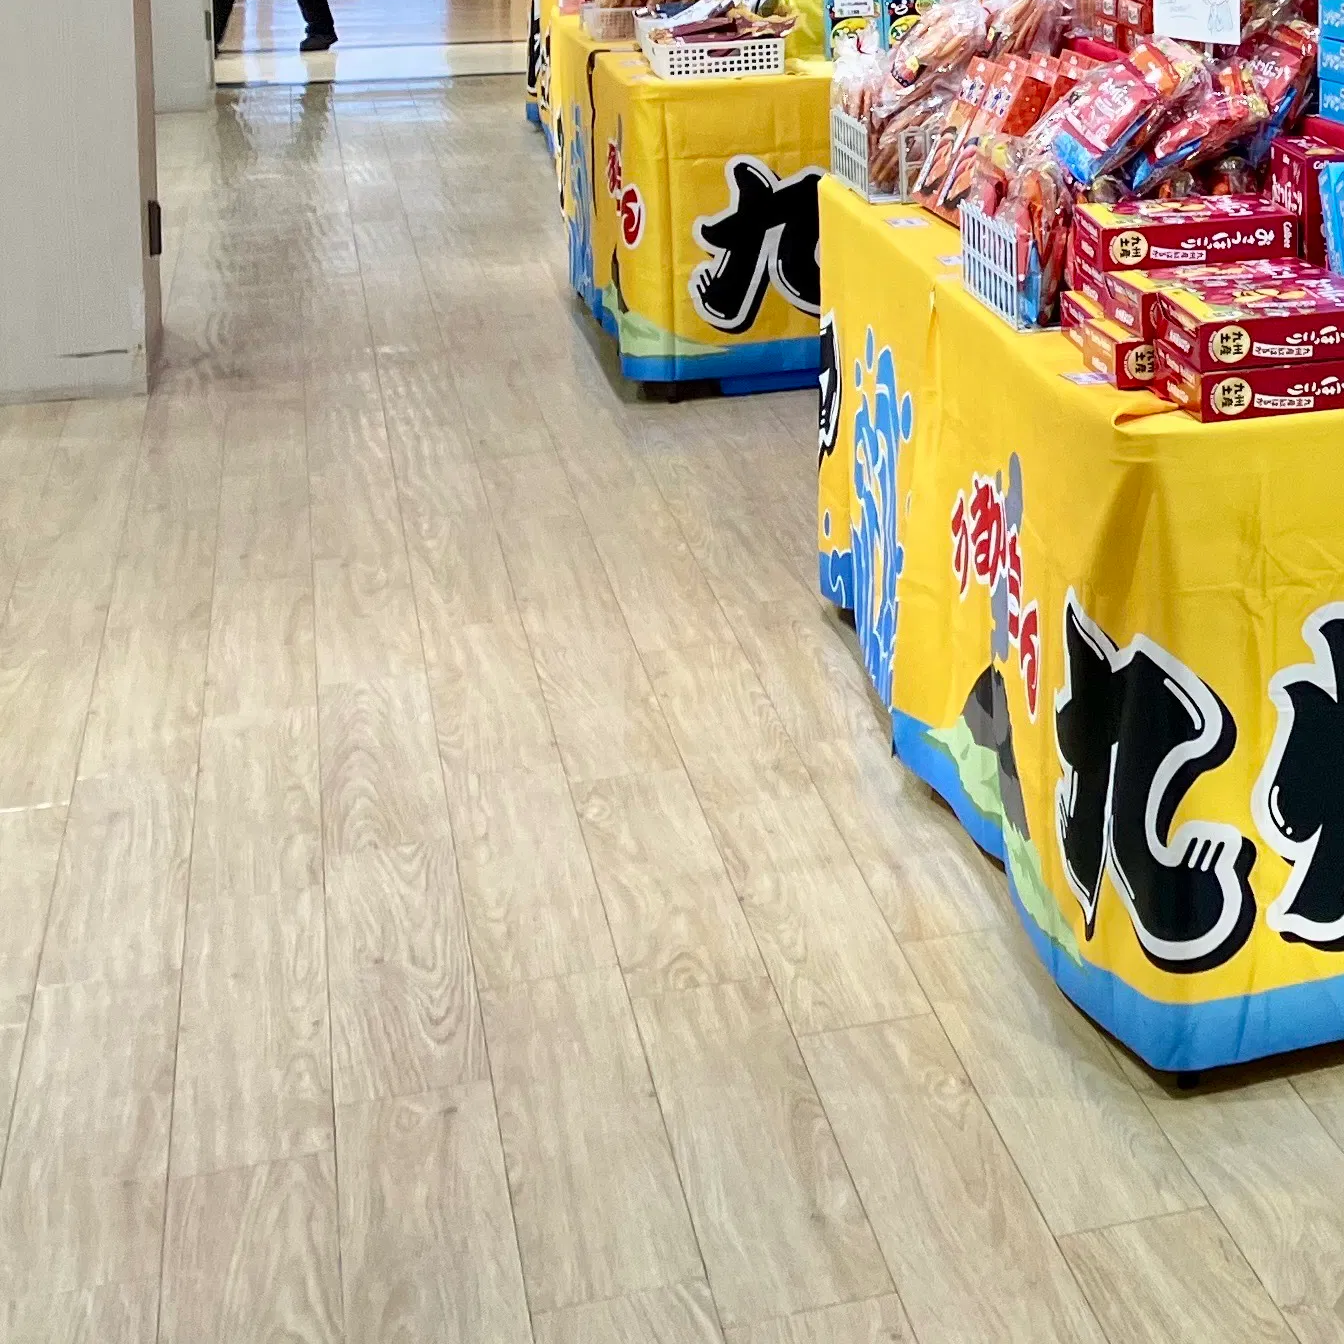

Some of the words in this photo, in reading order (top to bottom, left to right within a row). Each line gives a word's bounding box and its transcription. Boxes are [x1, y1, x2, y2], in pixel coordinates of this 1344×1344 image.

[1119, 237, 1131, 259] 土産
[1131, 236, 1142, 258] 九州
[1220, 333, 1231, 356] 土産
[1232, 331, 1243, 355] 九州
[1221, 385, 1233, 408] 土産
[1233, 382, 1244, 407] 九州
